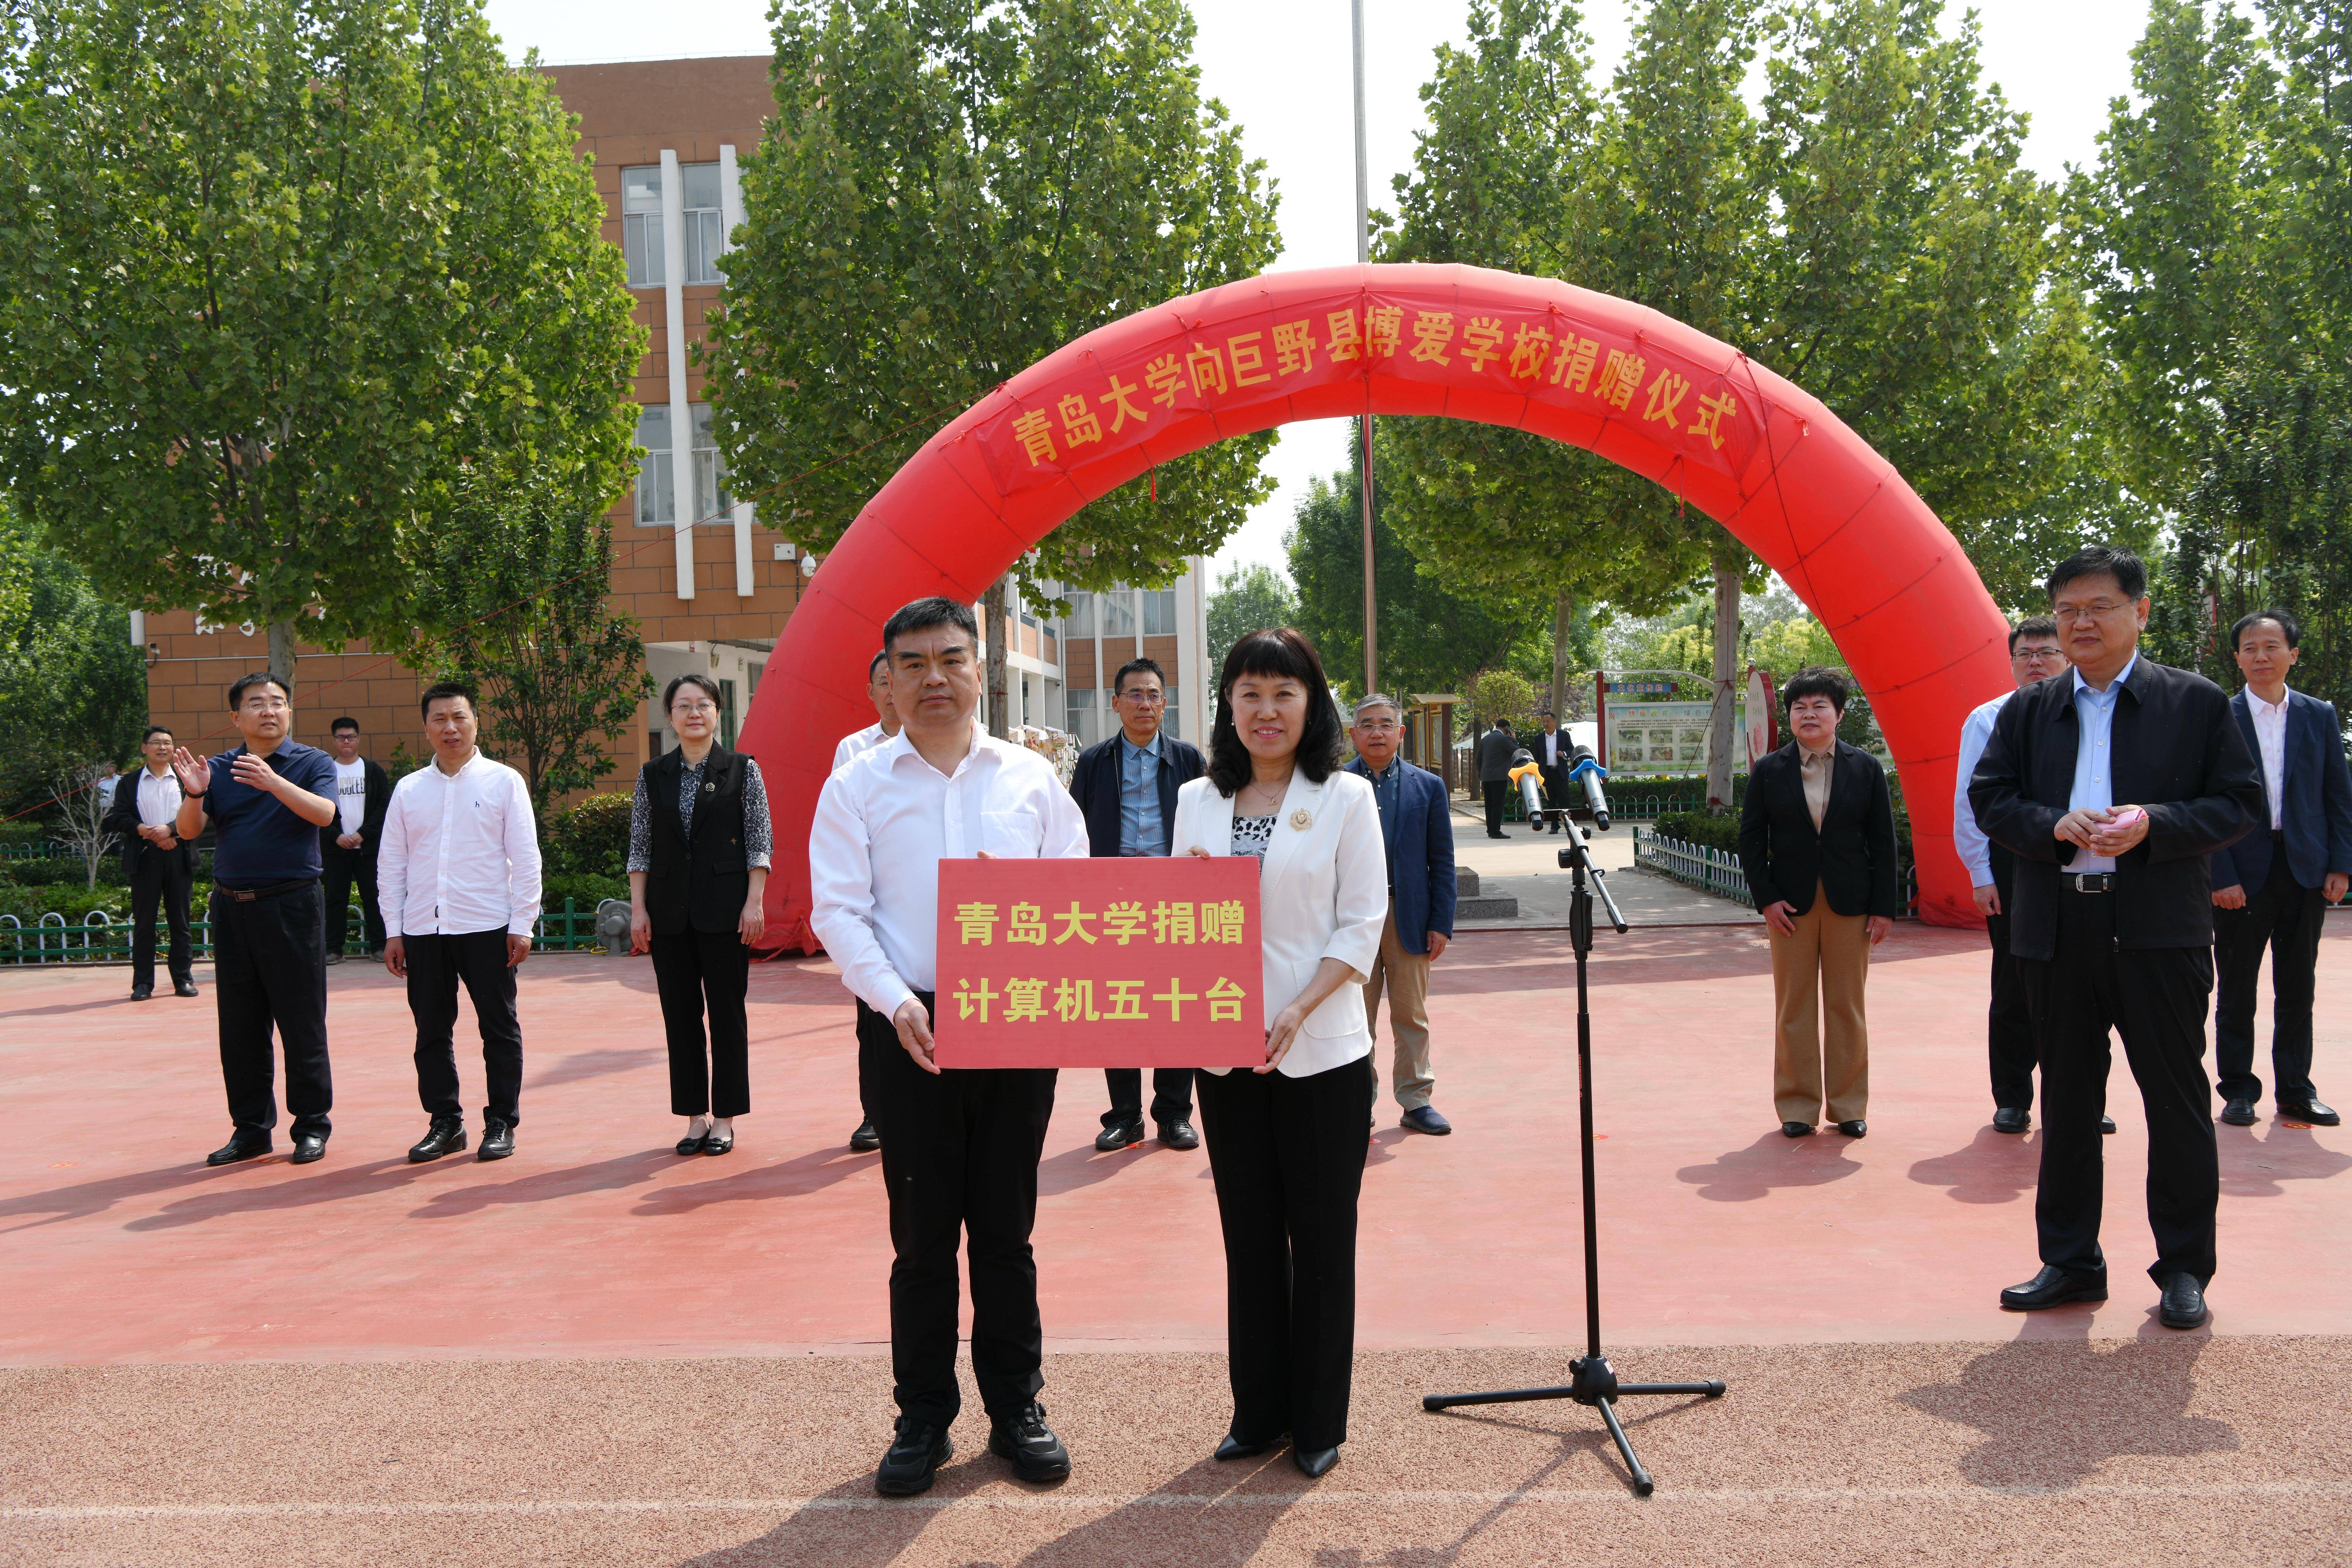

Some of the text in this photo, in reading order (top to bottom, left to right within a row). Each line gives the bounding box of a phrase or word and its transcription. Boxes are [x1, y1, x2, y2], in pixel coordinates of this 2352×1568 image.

[1012, 305, 1736, 466] 青岛大学向巨野县博爱学校捐赠仪式
[954, 900, 1245, 946] 青岛大学捐赠
[953, 977, 1247, 1023] 计算机五十台
